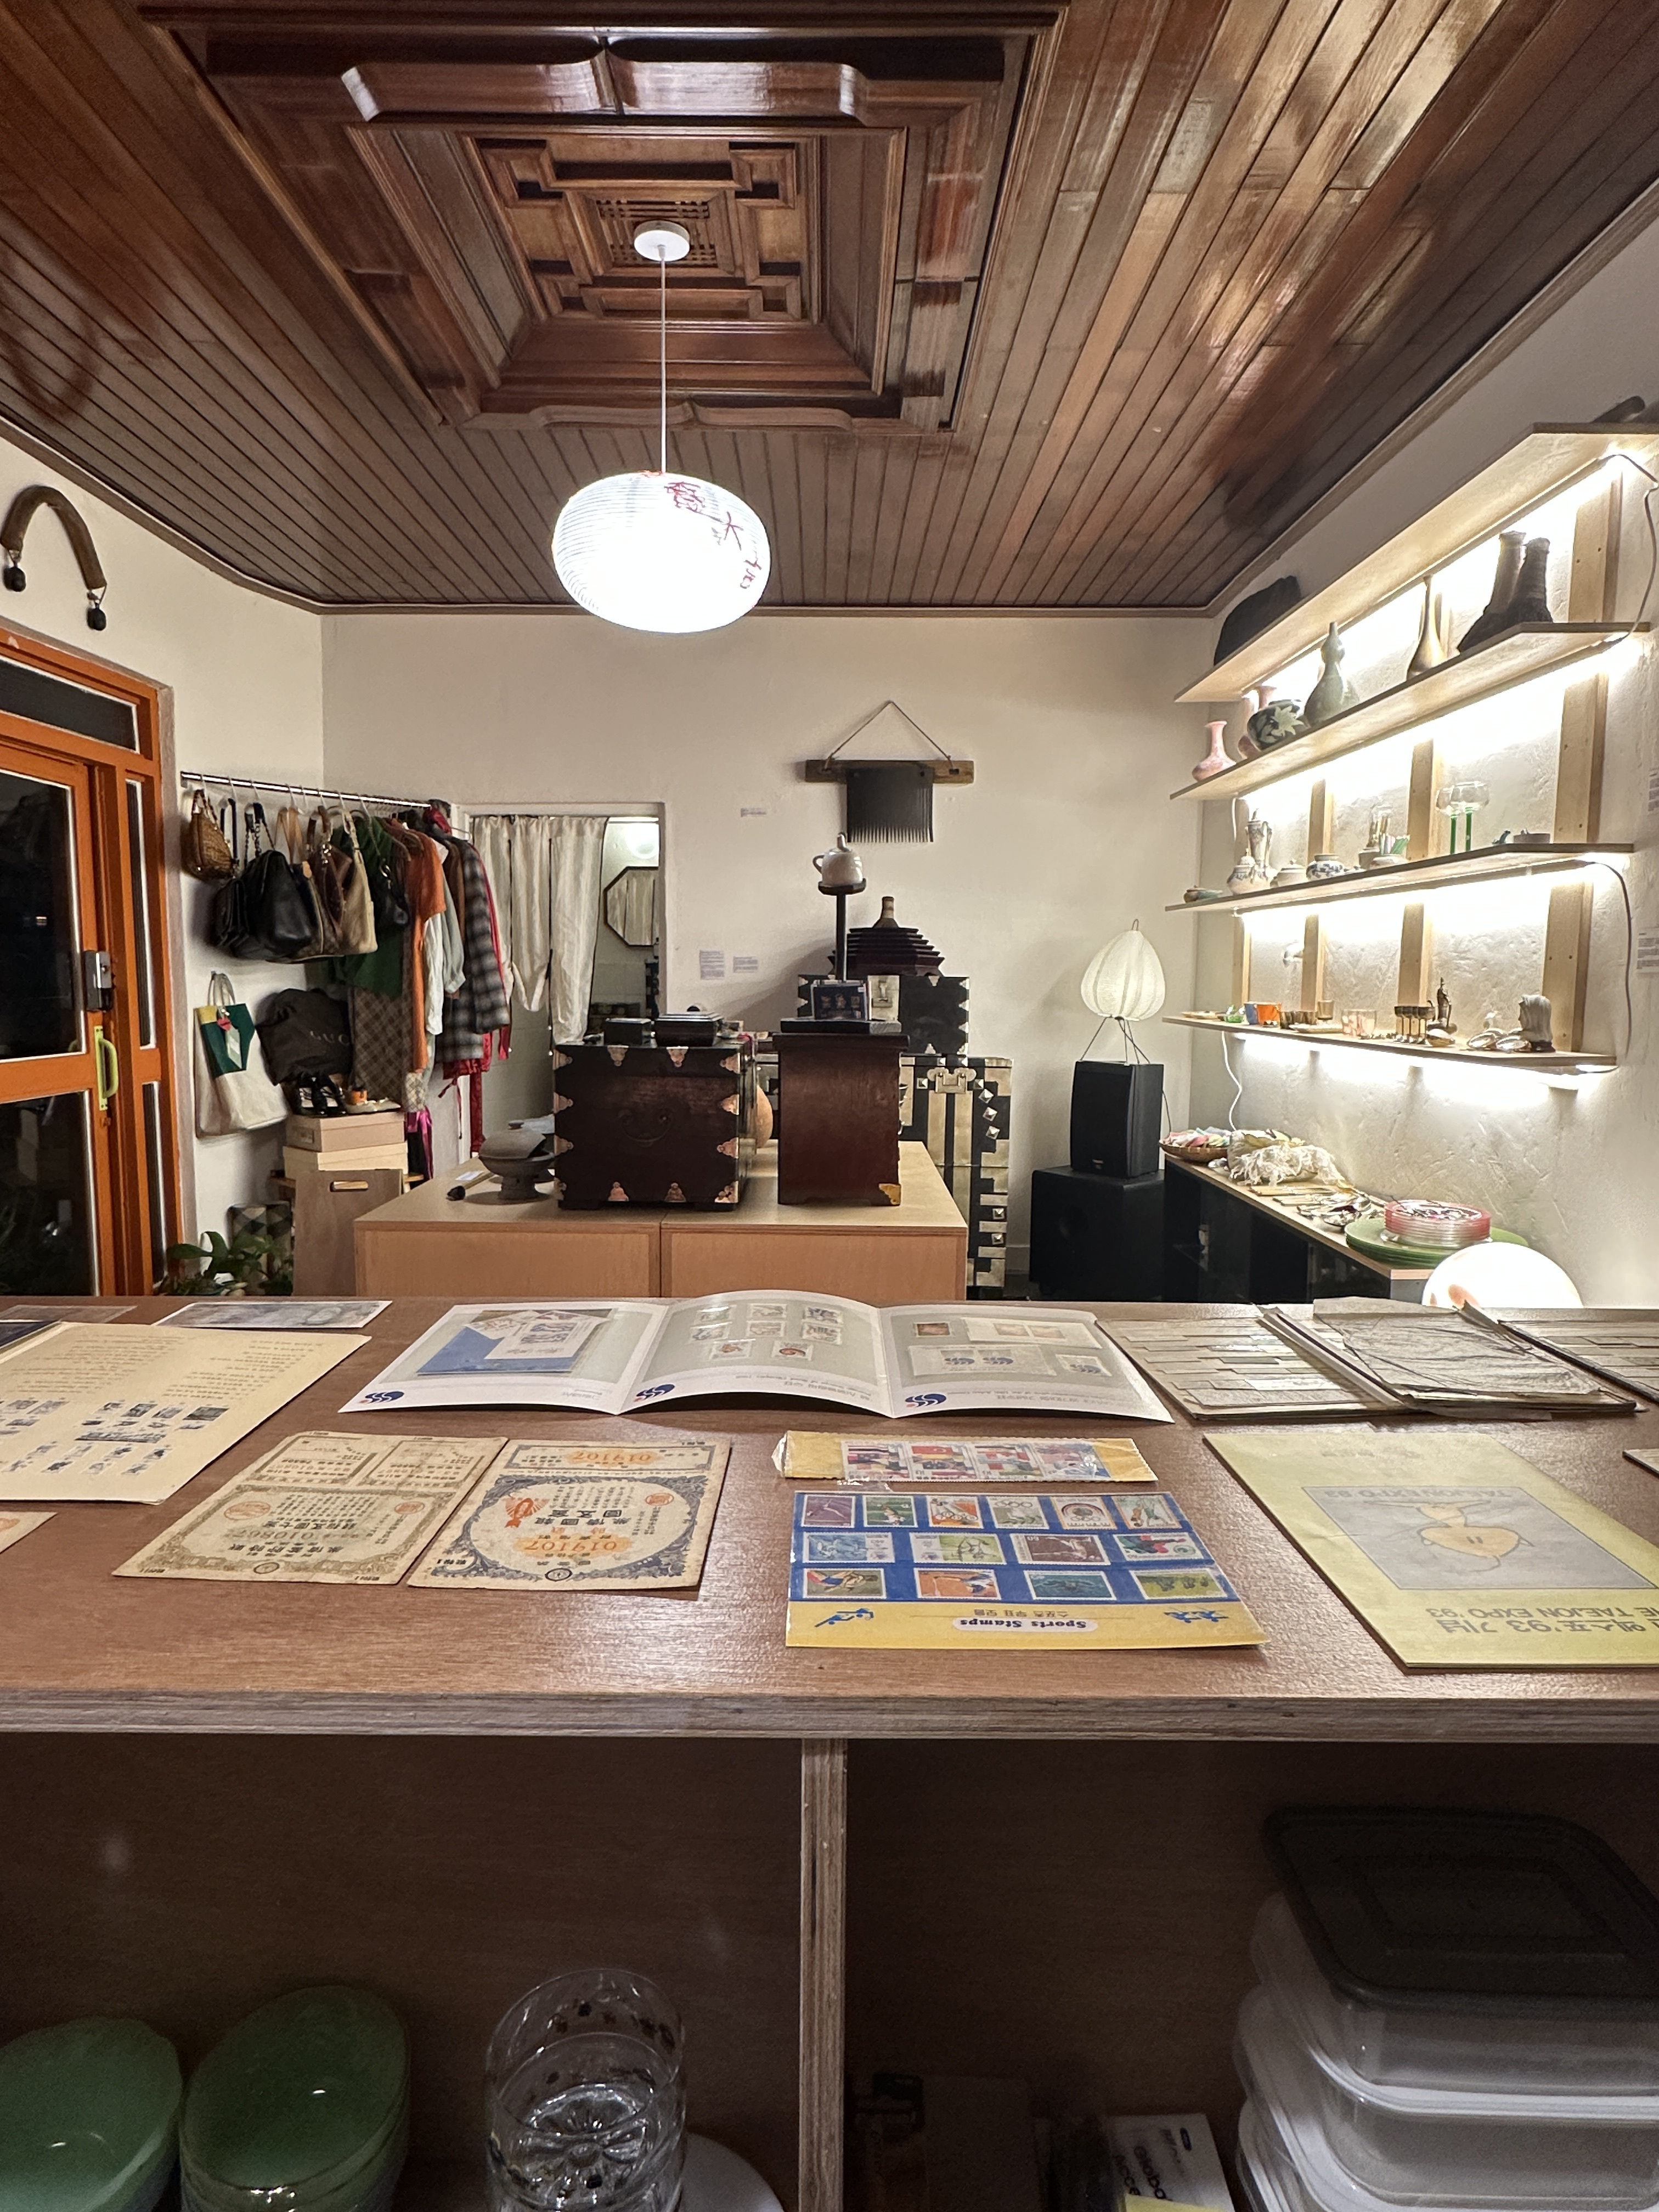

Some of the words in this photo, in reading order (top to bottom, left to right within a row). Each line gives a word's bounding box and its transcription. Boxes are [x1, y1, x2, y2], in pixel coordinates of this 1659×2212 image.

[524, 1541, 617, 1551] 019107
[1426, 1608, 1465, 1618] '93
[1467, 1608, 1534, 1618] EXPO
[1536, 1607, 1634, 1617] TAEJON
[960, 1618, 1022, 1628] Stamps
[1436, 1619, 1498, 1633] 기념
[1133, 2144, 1173, 2202] Globa
